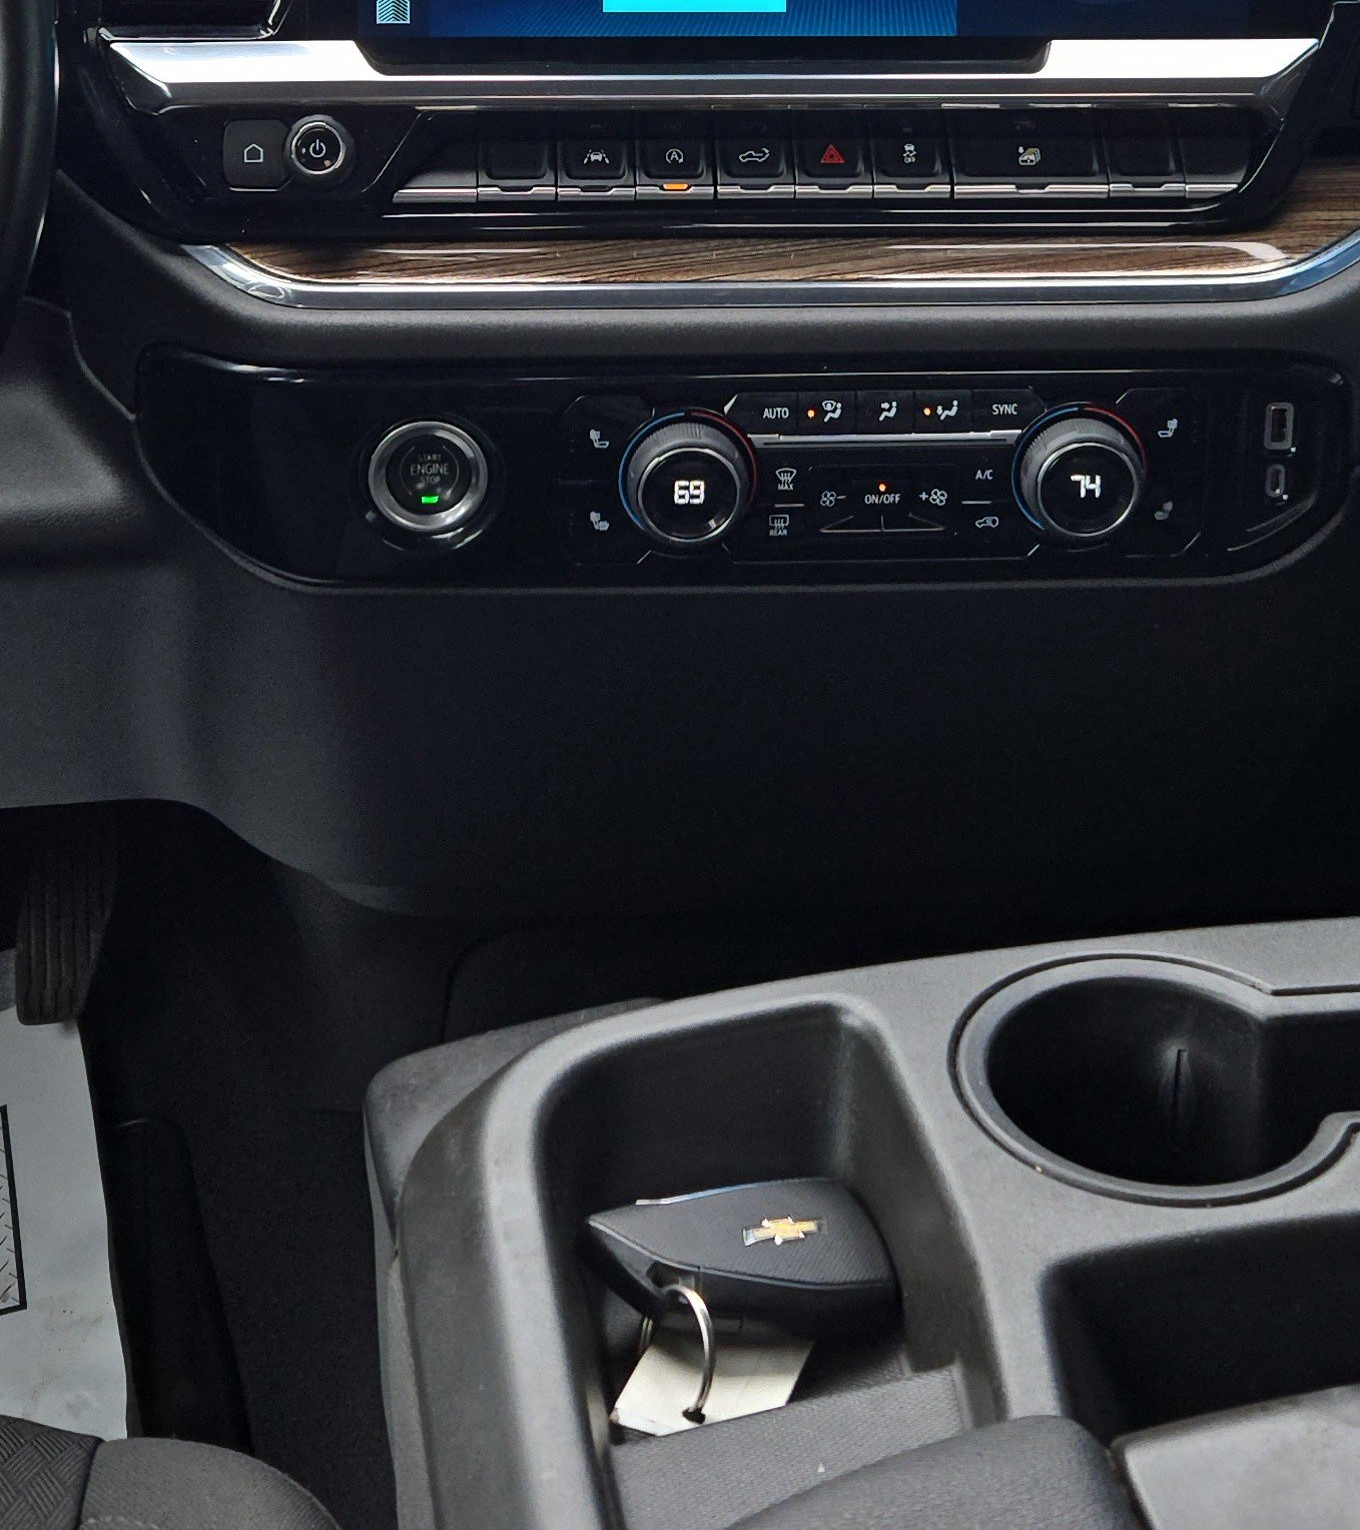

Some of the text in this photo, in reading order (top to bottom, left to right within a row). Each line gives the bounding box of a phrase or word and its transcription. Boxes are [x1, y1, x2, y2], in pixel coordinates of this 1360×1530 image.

[762, 408, 790, 419] AUTO
[992, 404, 1018, 416] SYNC
[410, 464, 450, 476] ENGINE
[975, 470, 994, 480] A/C
[420, 476, 440, 484] STOP
[1070, 474, 1101, 498] 74
[674, 480, 705, 505] 69
[864, 494, 900, 504] ON/OFF
